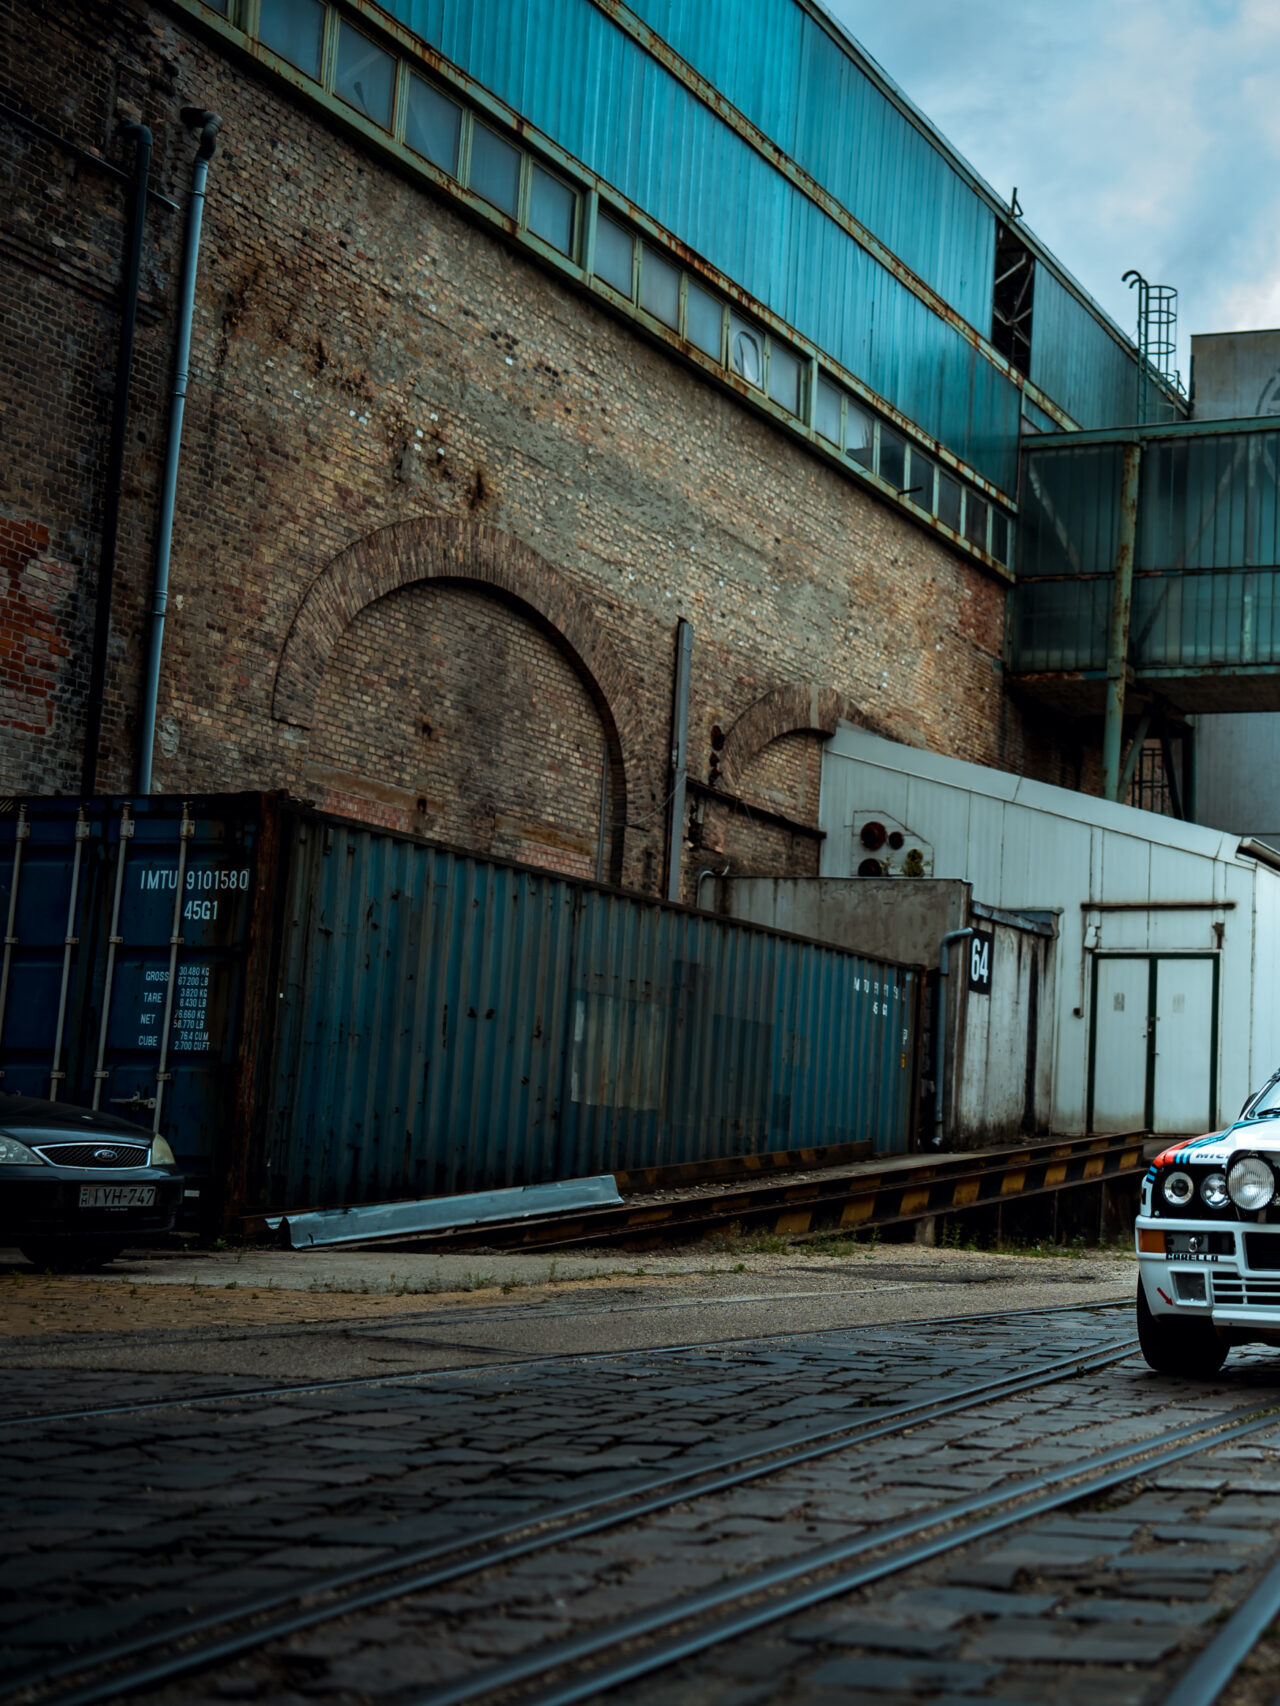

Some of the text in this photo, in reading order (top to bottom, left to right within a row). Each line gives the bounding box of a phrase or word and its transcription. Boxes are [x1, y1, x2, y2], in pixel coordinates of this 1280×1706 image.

[140, 870, 248, 890] IMTU 9101580
[184, 900, 218, 920] 45G1
[971, 938, 990, 984] 64
[145, 971, 170, 982] GROSS
[201, 967, 210, 976] KG
[200, 977, 209, 986] LB
[143, 992, 163, 1003] TARE
[200, 988, 208, 998] KG
[198, 999, 207, 1008] LB
[140, 1014, 156, 1025] NET
[197, 1010, 205, 1019] KG
[195, 1020, 204, 1029] LB
[138, 1035, 158, 1046] CUBE
